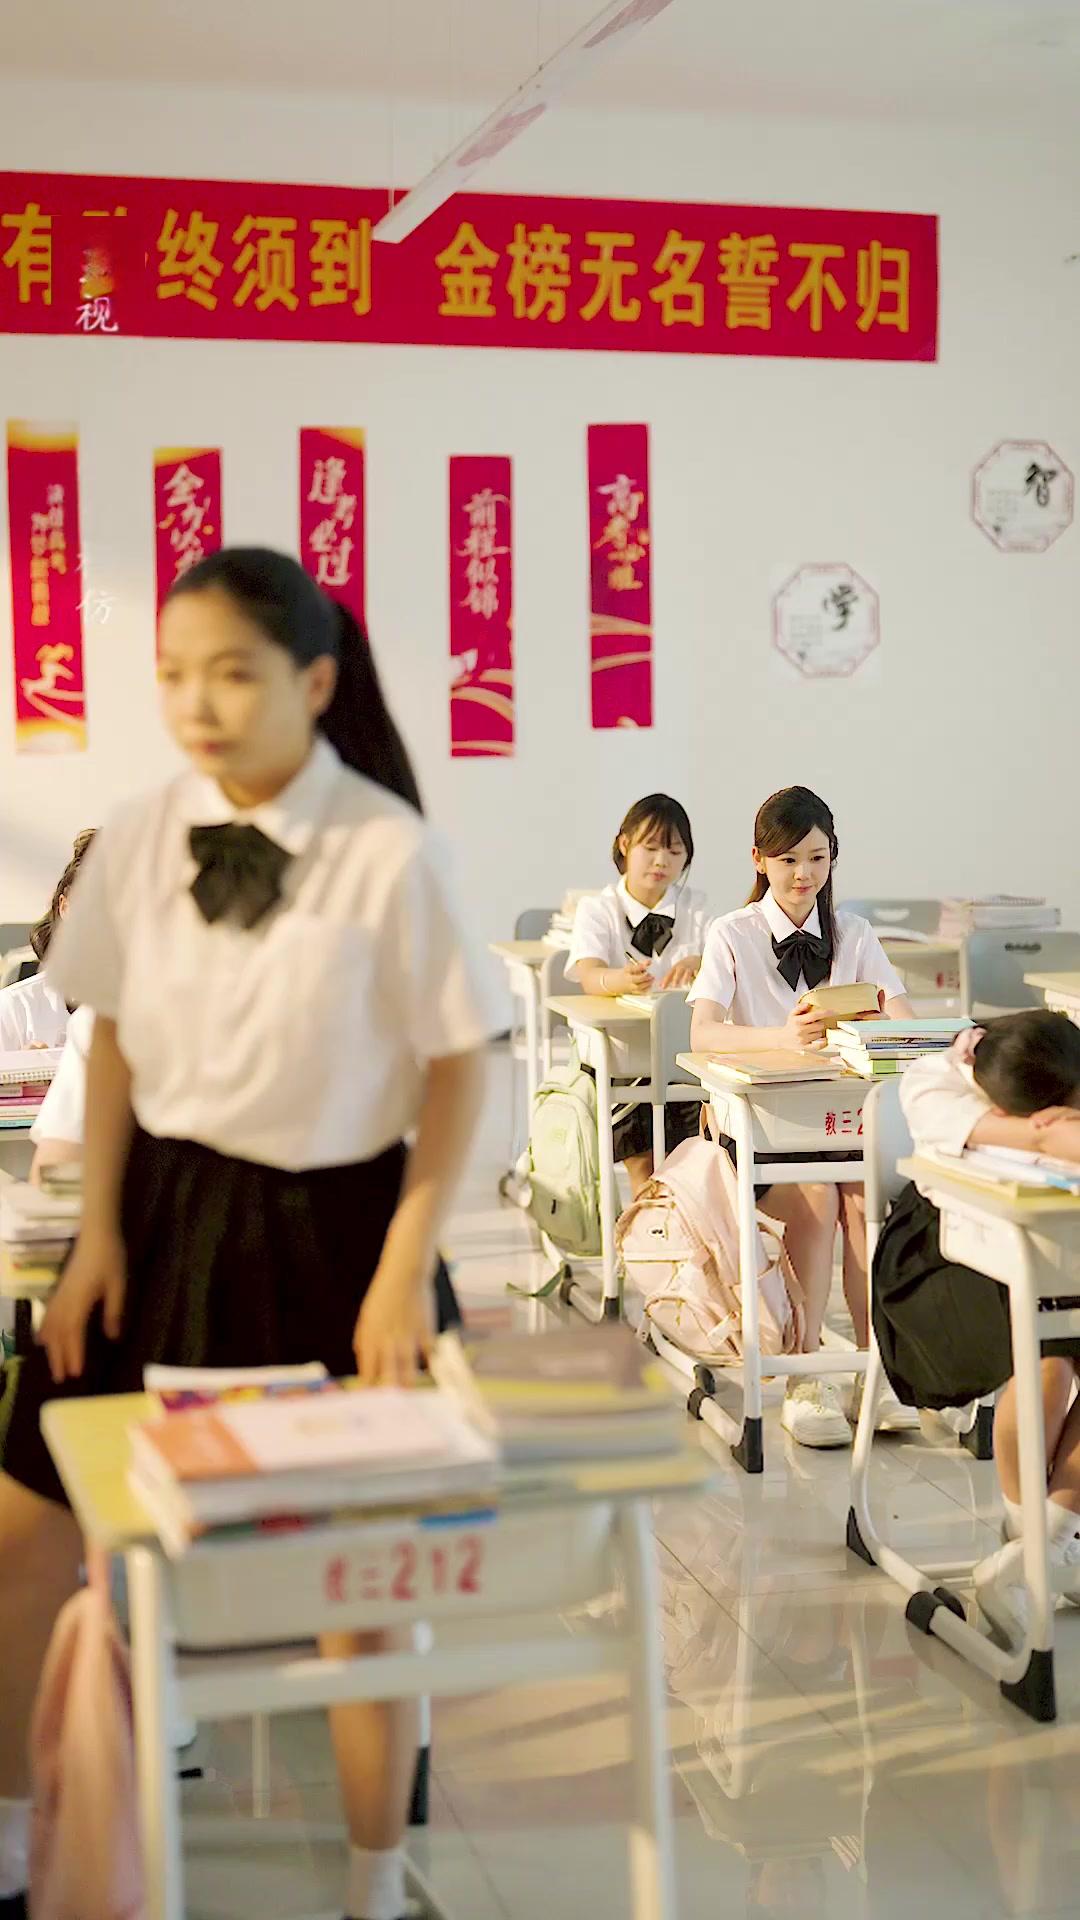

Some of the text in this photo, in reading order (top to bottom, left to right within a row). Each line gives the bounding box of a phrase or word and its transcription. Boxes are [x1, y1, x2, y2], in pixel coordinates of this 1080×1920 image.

[2, 202, 911, 333] 有终须到 金榜无名誓不归
[456, 487, 512, 620] 前程似锦
